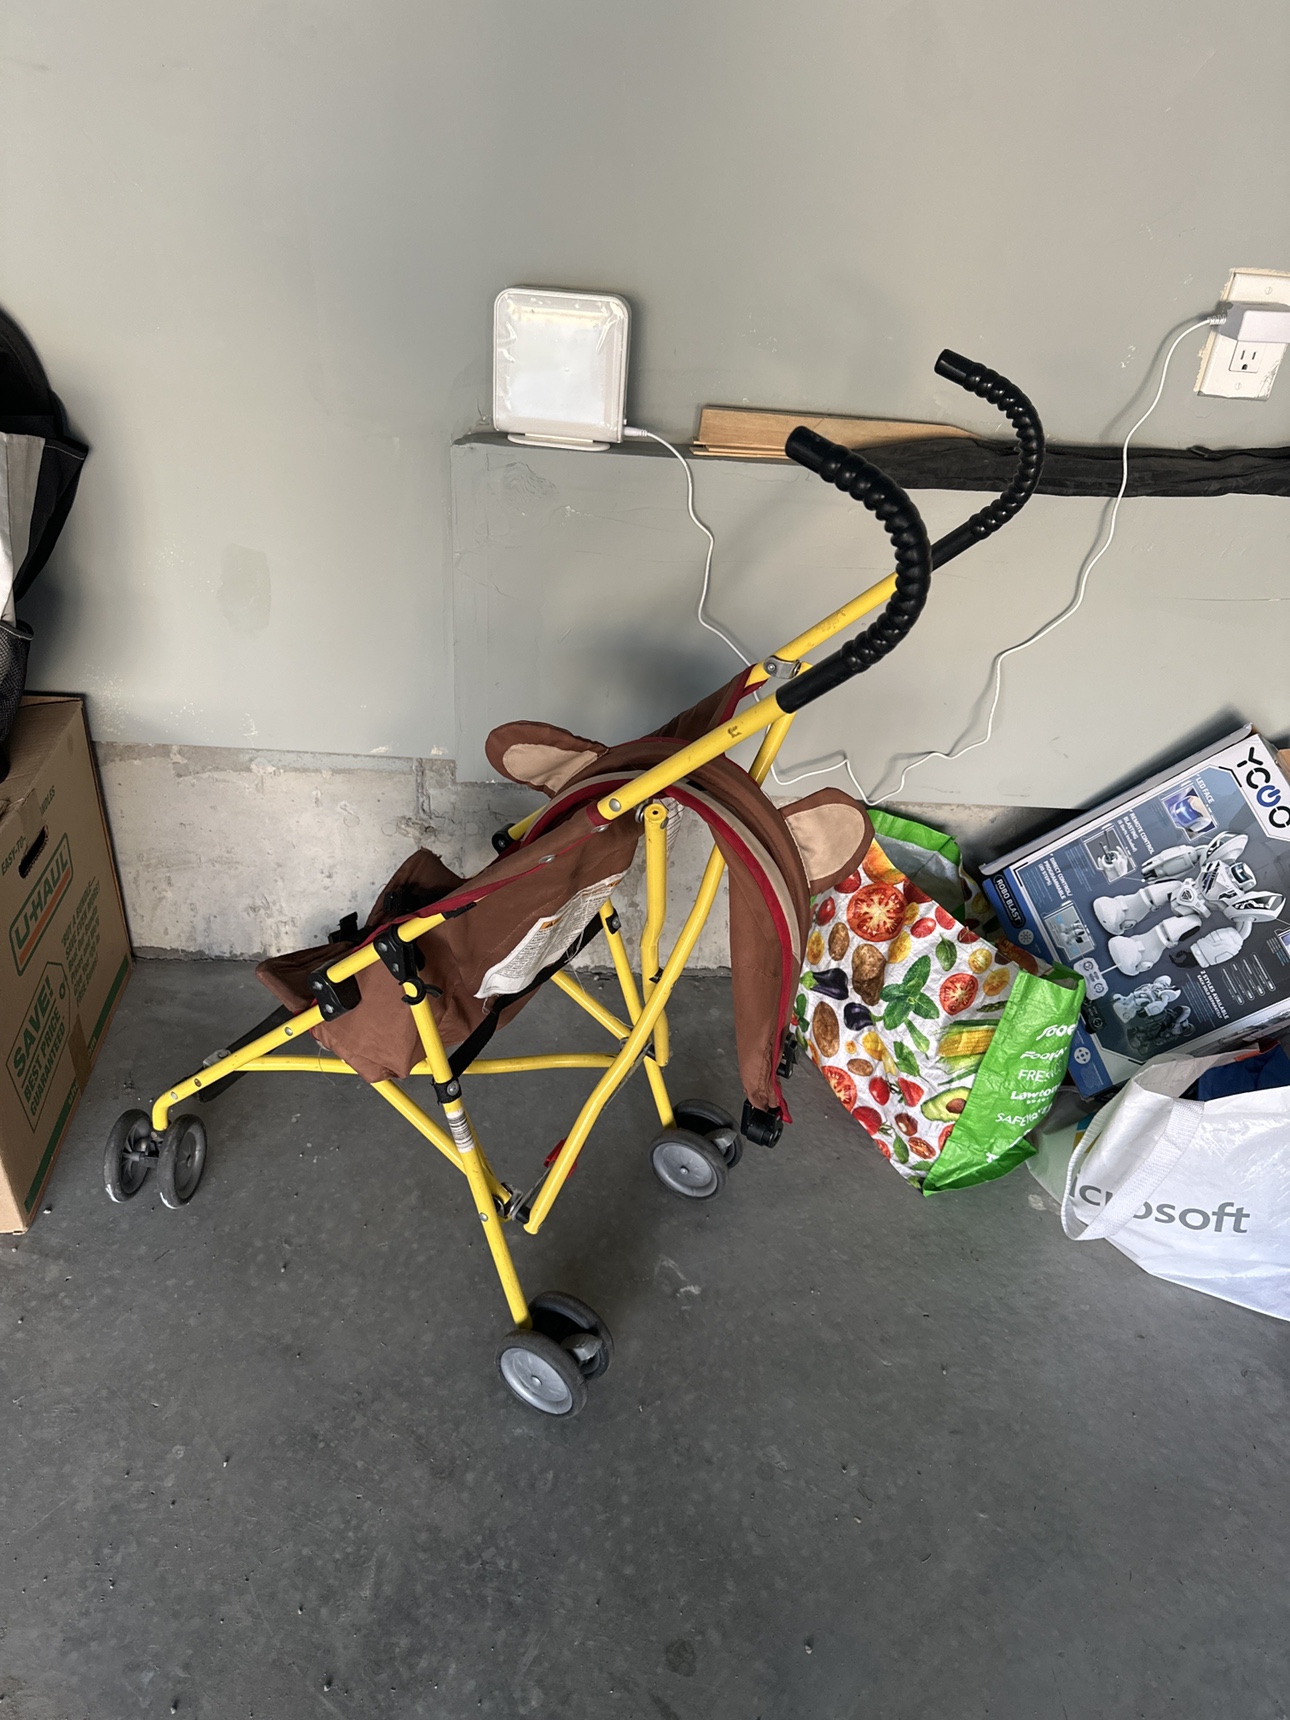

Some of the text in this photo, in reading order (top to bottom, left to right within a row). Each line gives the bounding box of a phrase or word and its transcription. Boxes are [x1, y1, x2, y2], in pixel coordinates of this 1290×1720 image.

[1202, 787, 1215, 804] FACE
[1122, 815, 1139, 840] BLASTING
[1129, 812, 1155, 854] REMOTE CONTROL
[14, 850, 69, 950] U-HAUL
[996, 878, 1021, 921] ROBO BLAST
[1201, 973, 1215, 993] STYLES
[1211, 992, 1229, 1019] AVAILABLE
[13, 974, 54, 1078] SAVE!
[24, 1006, 61, 1103] BEST PRICE
[30, 1022, 66, 1116] GUARANTEED
[1010, 1082, 1062, 1100] Lawton
